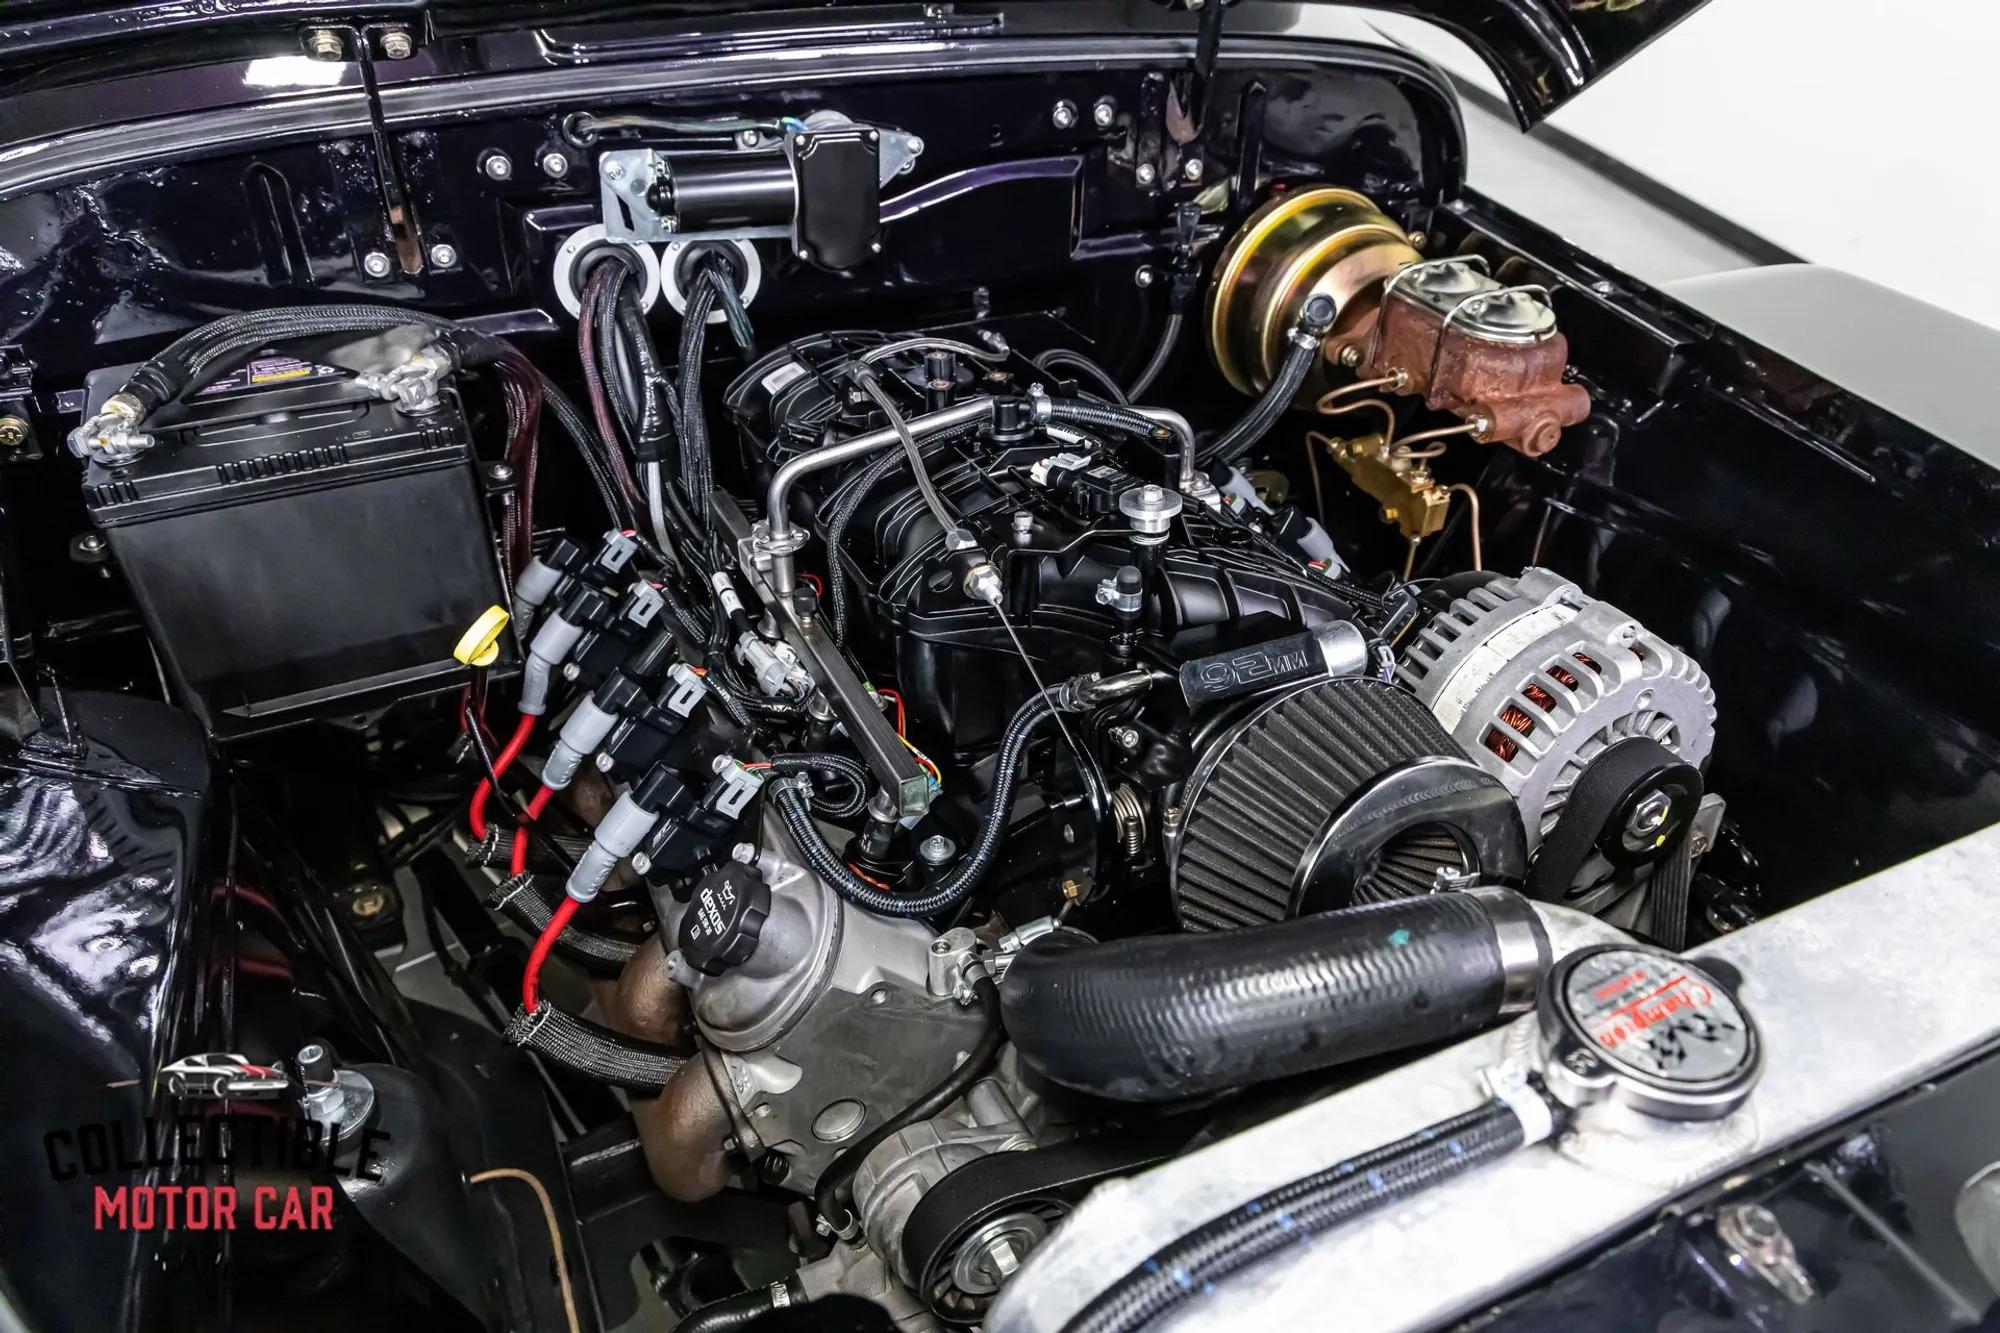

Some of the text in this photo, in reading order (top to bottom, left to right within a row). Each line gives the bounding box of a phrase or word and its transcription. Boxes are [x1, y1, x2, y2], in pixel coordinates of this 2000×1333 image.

[1200, 650, 1309, 692] 92MM
[700, 888, 727, 936] dexos
[1598, 983, 1713, 1049] Champion
